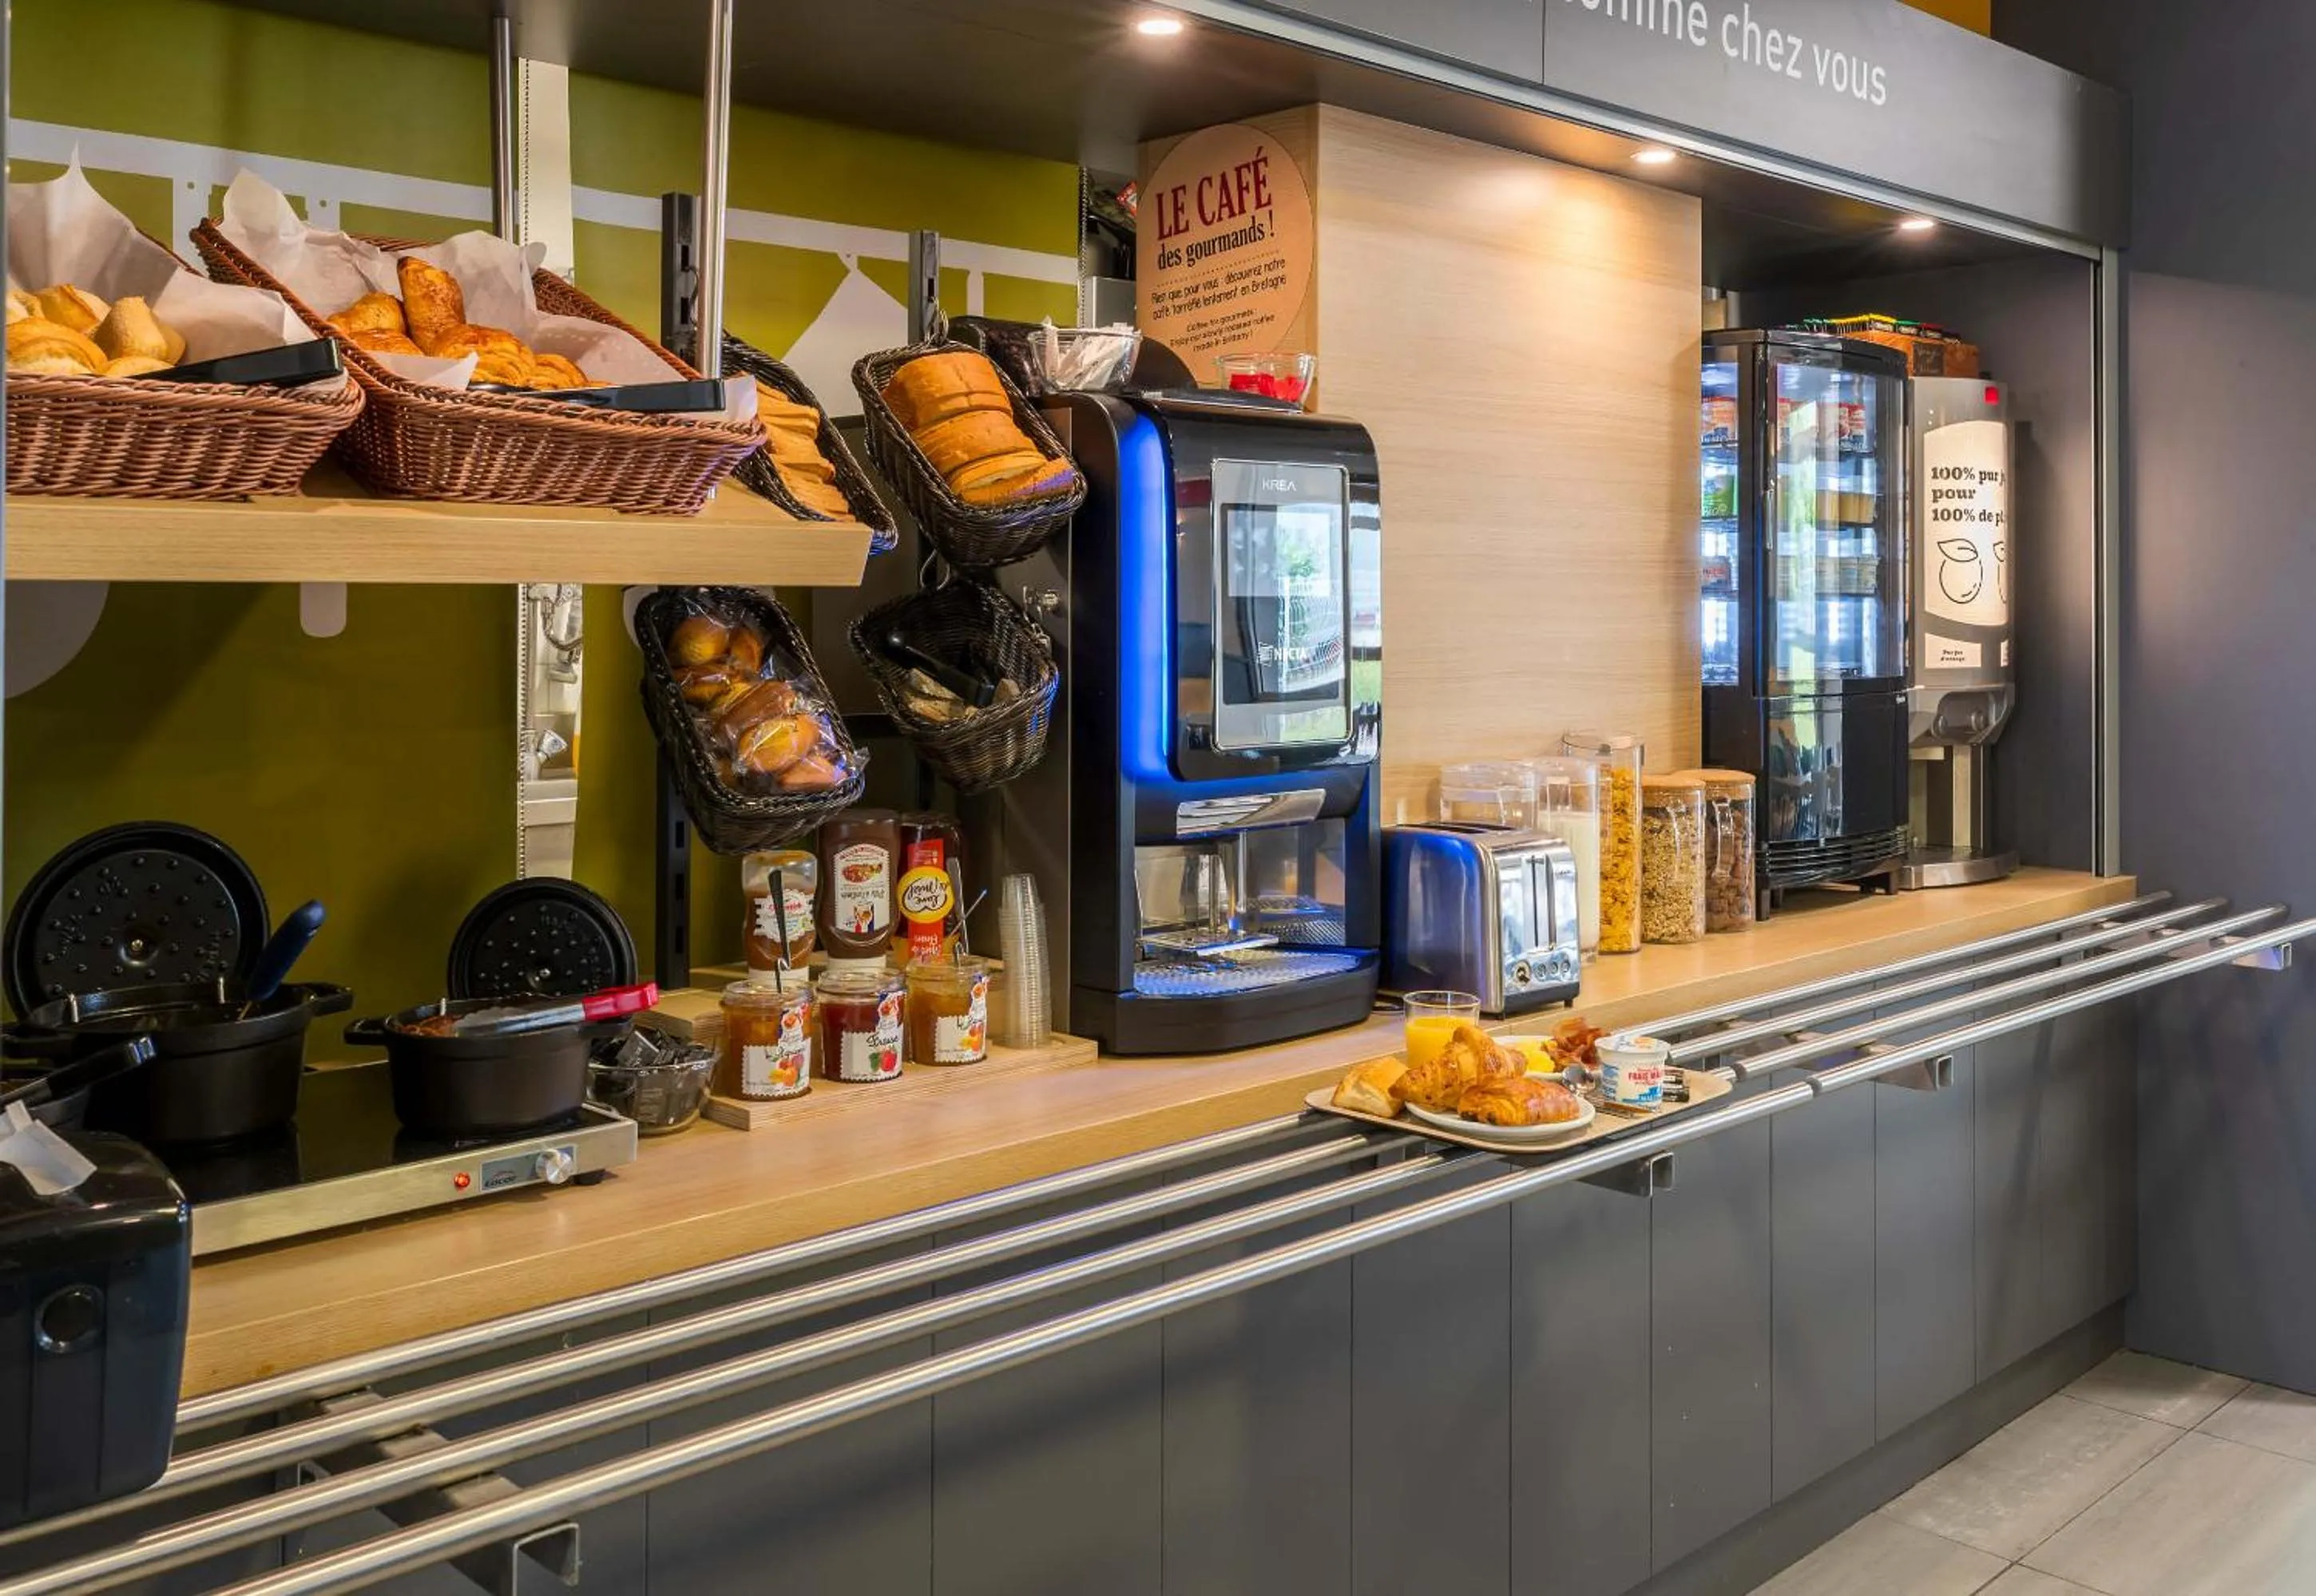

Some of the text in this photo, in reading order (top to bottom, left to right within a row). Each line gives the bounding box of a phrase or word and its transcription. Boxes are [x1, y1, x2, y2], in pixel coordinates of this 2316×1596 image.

[1721, 2, 1802, 79] chez
[1813, 42, 1888, 106] vous
[1156, 145, 1272, 241] LE CAFÉ
[1157, 244, 1182, 271] des
[1186, 215, 1265, 268] gourmands
[1152, 305, 1170, 320] café
[1240, 284, 1250, 296] en
[1251, 274, 1287, 294] Bretagne
[1168, 288, 1184, 301] que
[1184, 284, 1200, 298] pour
[1263, 258, 1286, 273] notre
[1262, 477, 1298, 492] KREA
[1930, 466, 1976, 481] 100%
[1978, 470, 1999, 485] pur
[1931, 488, 1976, 504] pour
[1931, 508, 1976, 522] 100%
[1978, 509, 1994, 523] de
